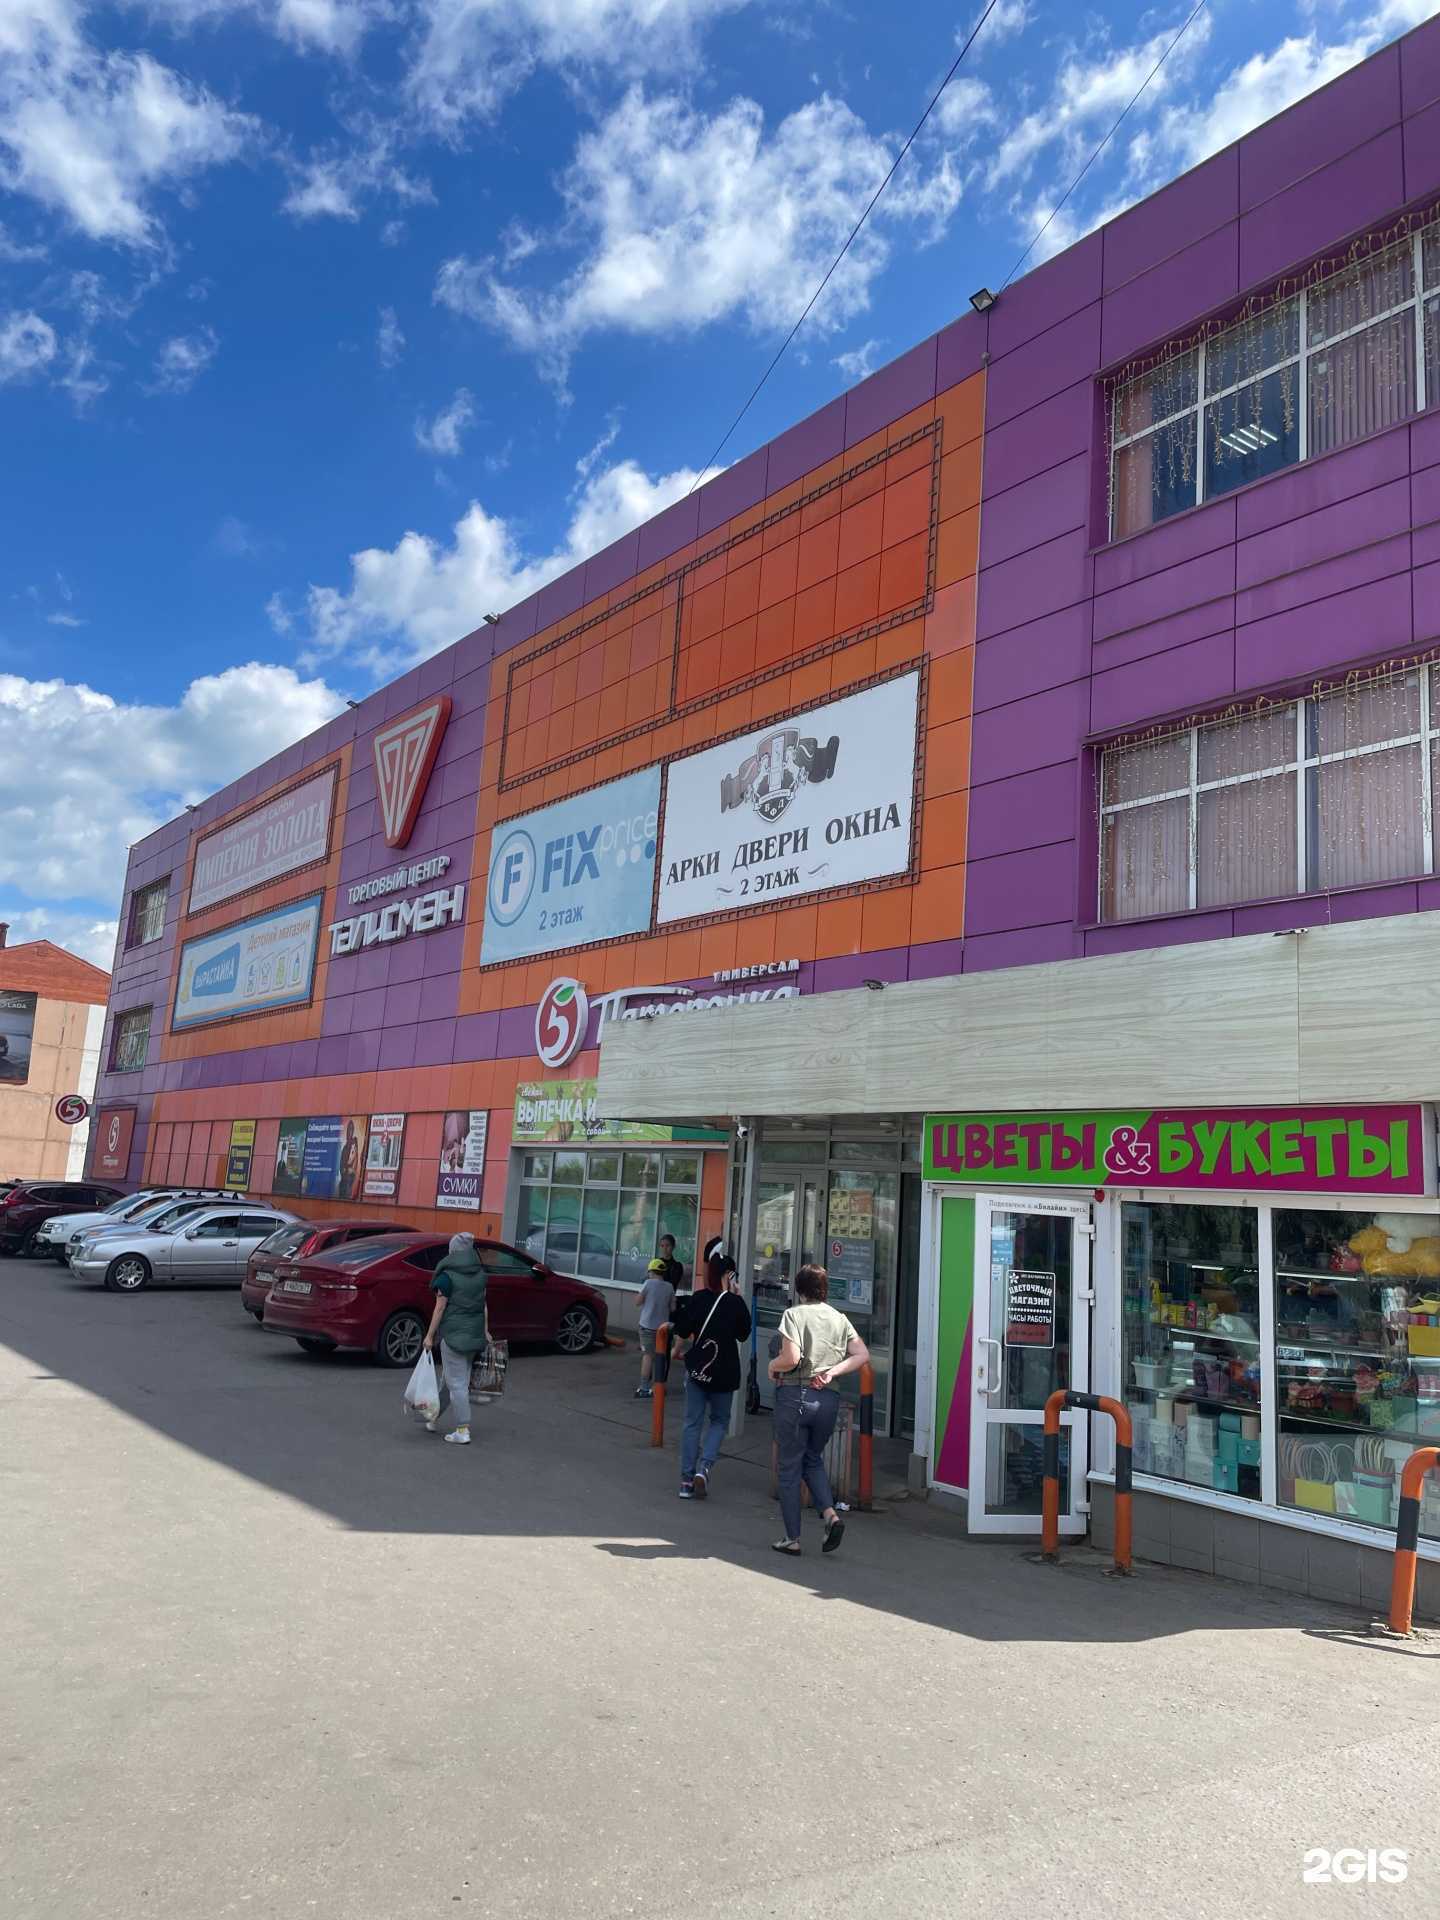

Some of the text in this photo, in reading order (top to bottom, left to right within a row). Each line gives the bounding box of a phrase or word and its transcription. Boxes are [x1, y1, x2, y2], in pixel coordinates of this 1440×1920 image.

[262, 801, 326, 858] ЗОЛОТА
[667, 802, 901, 886] АРКИ ДВЕРИ ОКНА
[347, 866, 408, 905] ТОРГОВЫЙ
[407, 855, 451, 887] ЦЕНТР
[740, 866, 800, 896] 2 ЭТАЖ
[538, 905, 584, 931] 2 этаж
[517, 1098, 583, 1123] ВЫПЕЧКА
[932, 1119, 1409, 1179] ЦВЕТЫ & БУКЕТЫ
[442, 1177, 478, 1194] СУМКИ
[1008, 1284, 1052, 1296] ЦВЕТОЧНЫЙ
[1010, 1295, 1049, 1306] МАГАЗИН
[1008, 1314, 1051, 1323] ЧАСЫ РАБОТЫ
